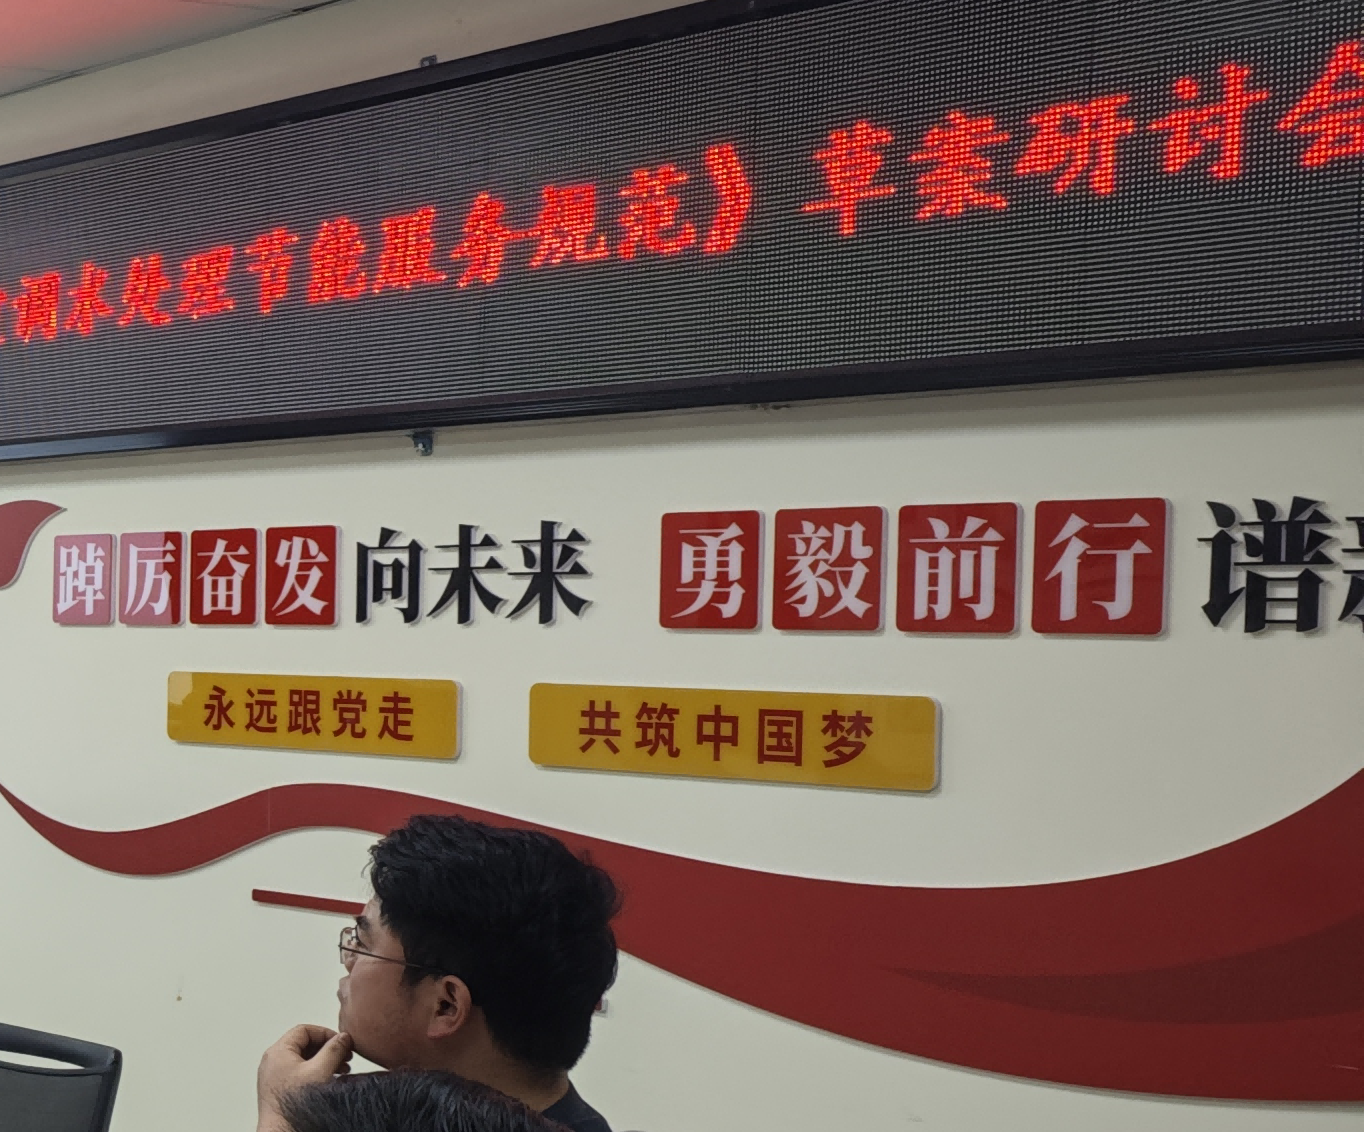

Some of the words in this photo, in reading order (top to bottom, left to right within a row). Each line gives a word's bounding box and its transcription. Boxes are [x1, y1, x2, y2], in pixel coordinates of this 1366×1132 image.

[203, 686, 414, 741] 永远跟党走
[579, 700, 874, 768] 共筑中国梦
